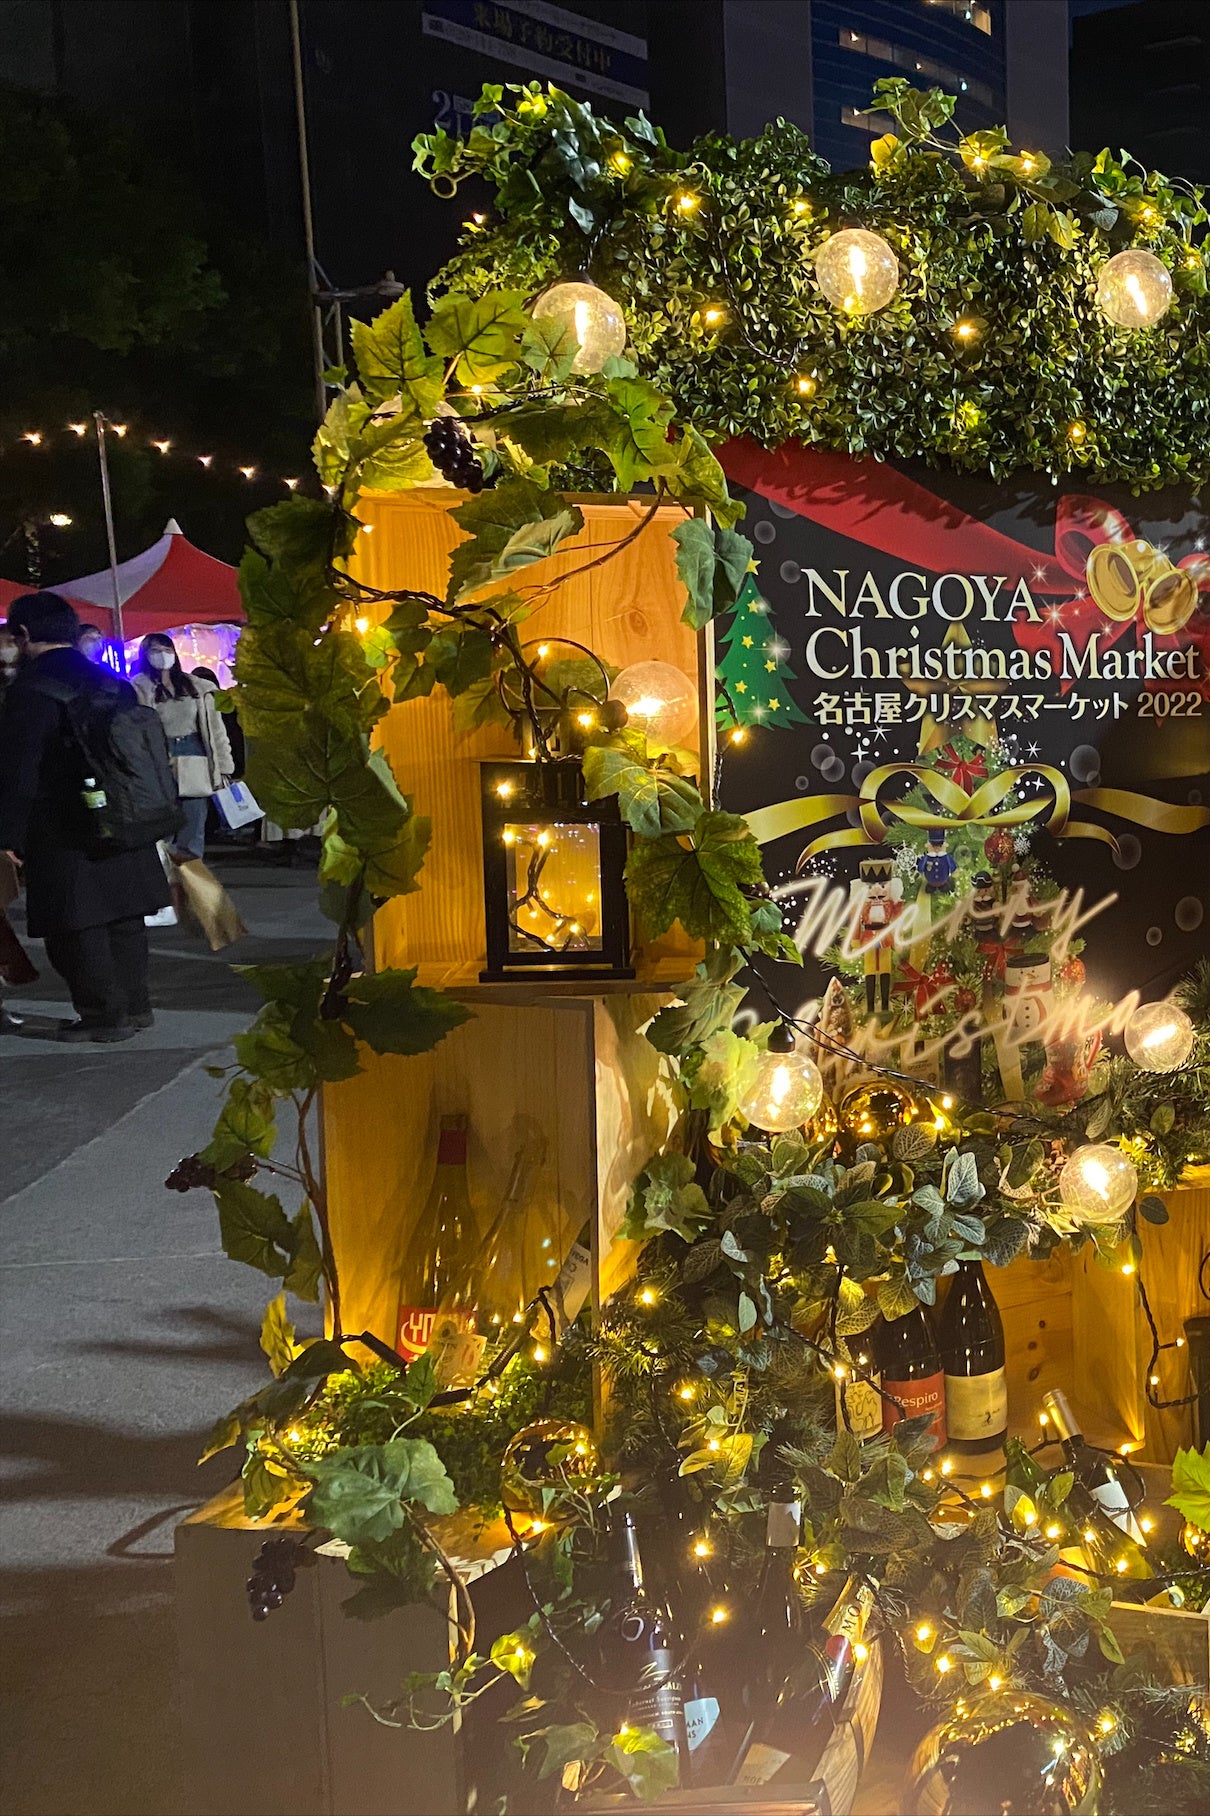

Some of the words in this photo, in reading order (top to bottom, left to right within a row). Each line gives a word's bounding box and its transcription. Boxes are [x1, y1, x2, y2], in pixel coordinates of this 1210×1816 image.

[801, 568, 1043, 622] NAGOYA
[805, 624, 1052, 680] Christmas
[1058, 632, 1200, 680] Market
[813, 692, 1129, 725] 名古屋クリスマスマーケット
[1137, 692, 1203, 717] 2022
[769, 874, 1119, 966] Merry
